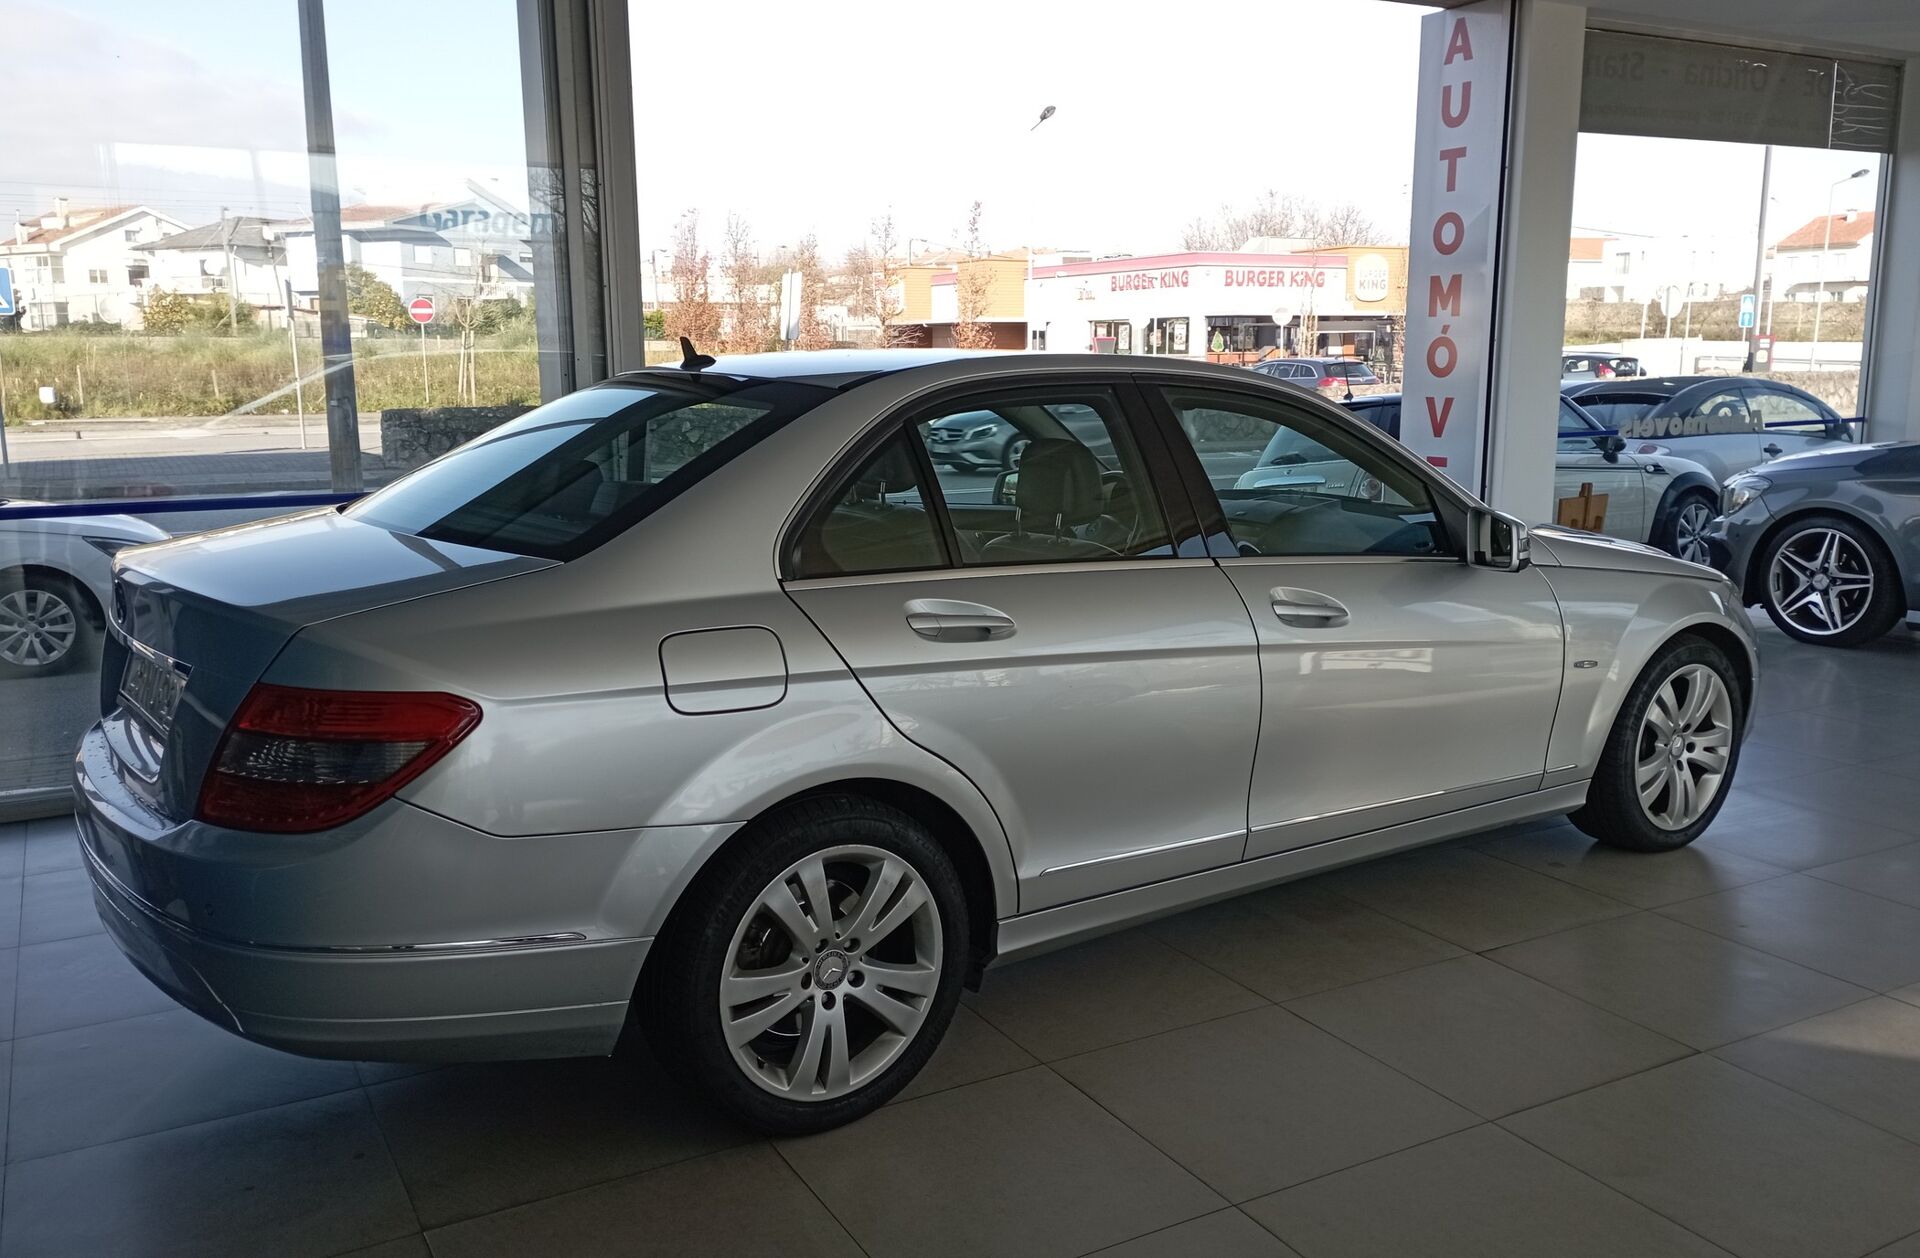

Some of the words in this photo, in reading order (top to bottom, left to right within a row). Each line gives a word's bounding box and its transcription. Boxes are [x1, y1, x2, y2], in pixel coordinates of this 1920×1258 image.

[1426, 17, 1473, 468] AUTOMÓV
[1111, 273, 1156, 292] BURGER
[1160, 269, 1190, 288] KING
[1224, 269, 1285, 287] BURGER
[1289, 270, 1326, 288] KING
[1359, 279, 1387, 290] KING
